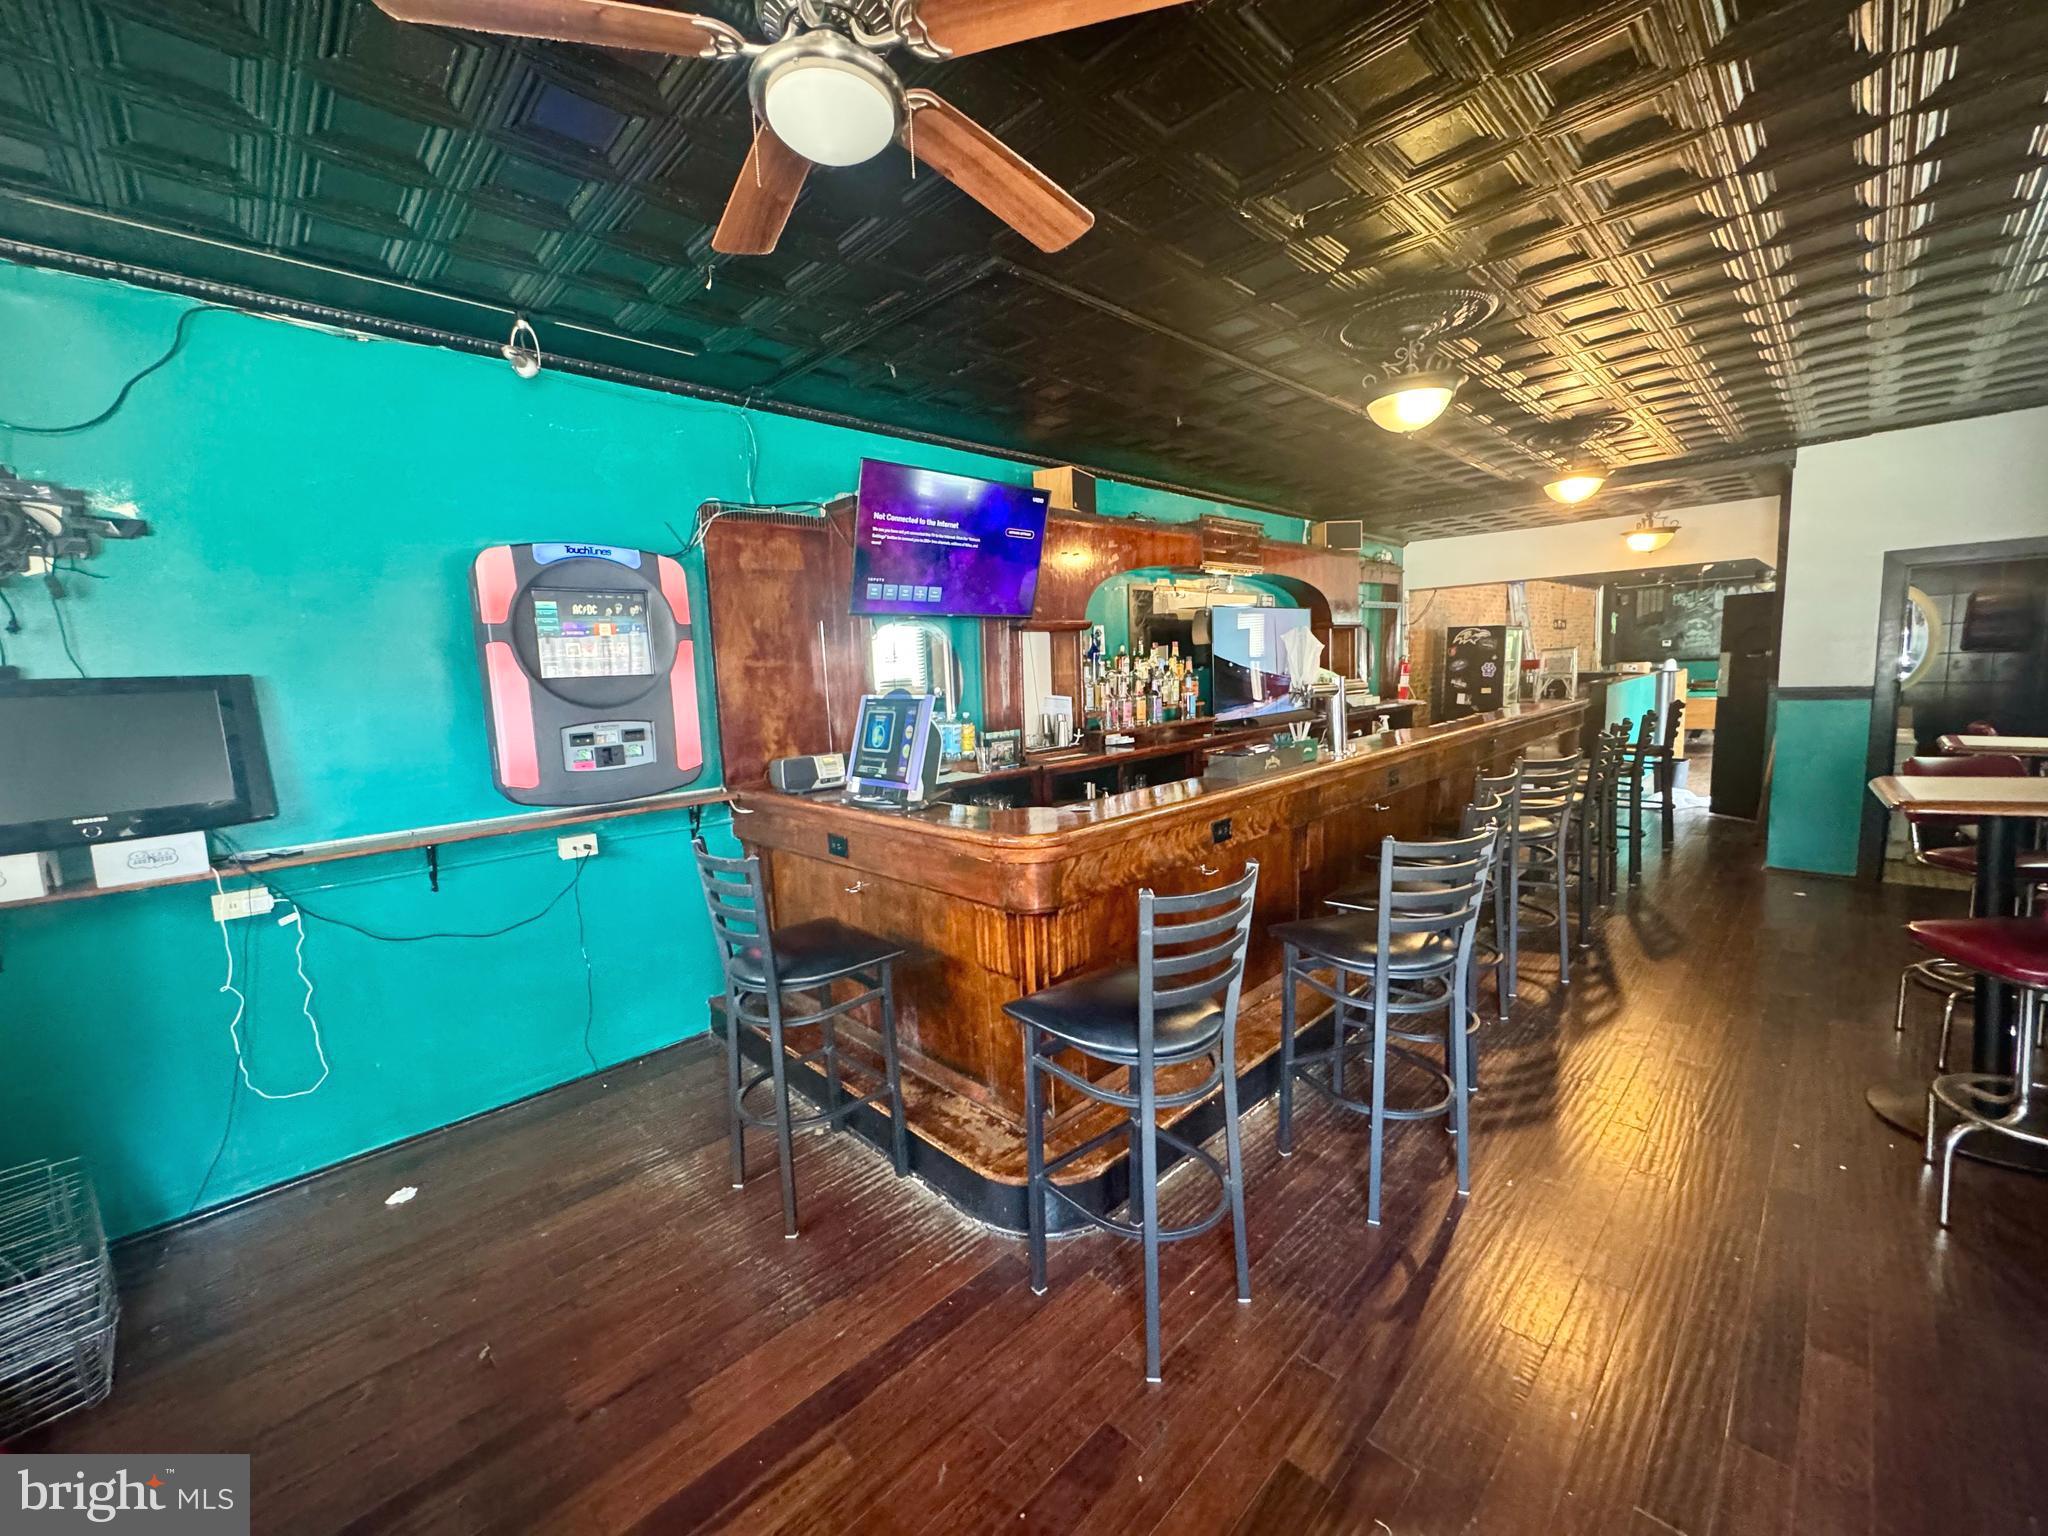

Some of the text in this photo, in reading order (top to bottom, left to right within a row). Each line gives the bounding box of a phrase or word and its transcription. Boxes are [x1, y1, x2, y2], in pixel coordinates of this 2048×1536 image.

[873, 511, 959, 529] Not Connected to the Internet
[564, 545, 612, 556] TouchTunes
[72, 816, 109, 825] SAMSUNG
